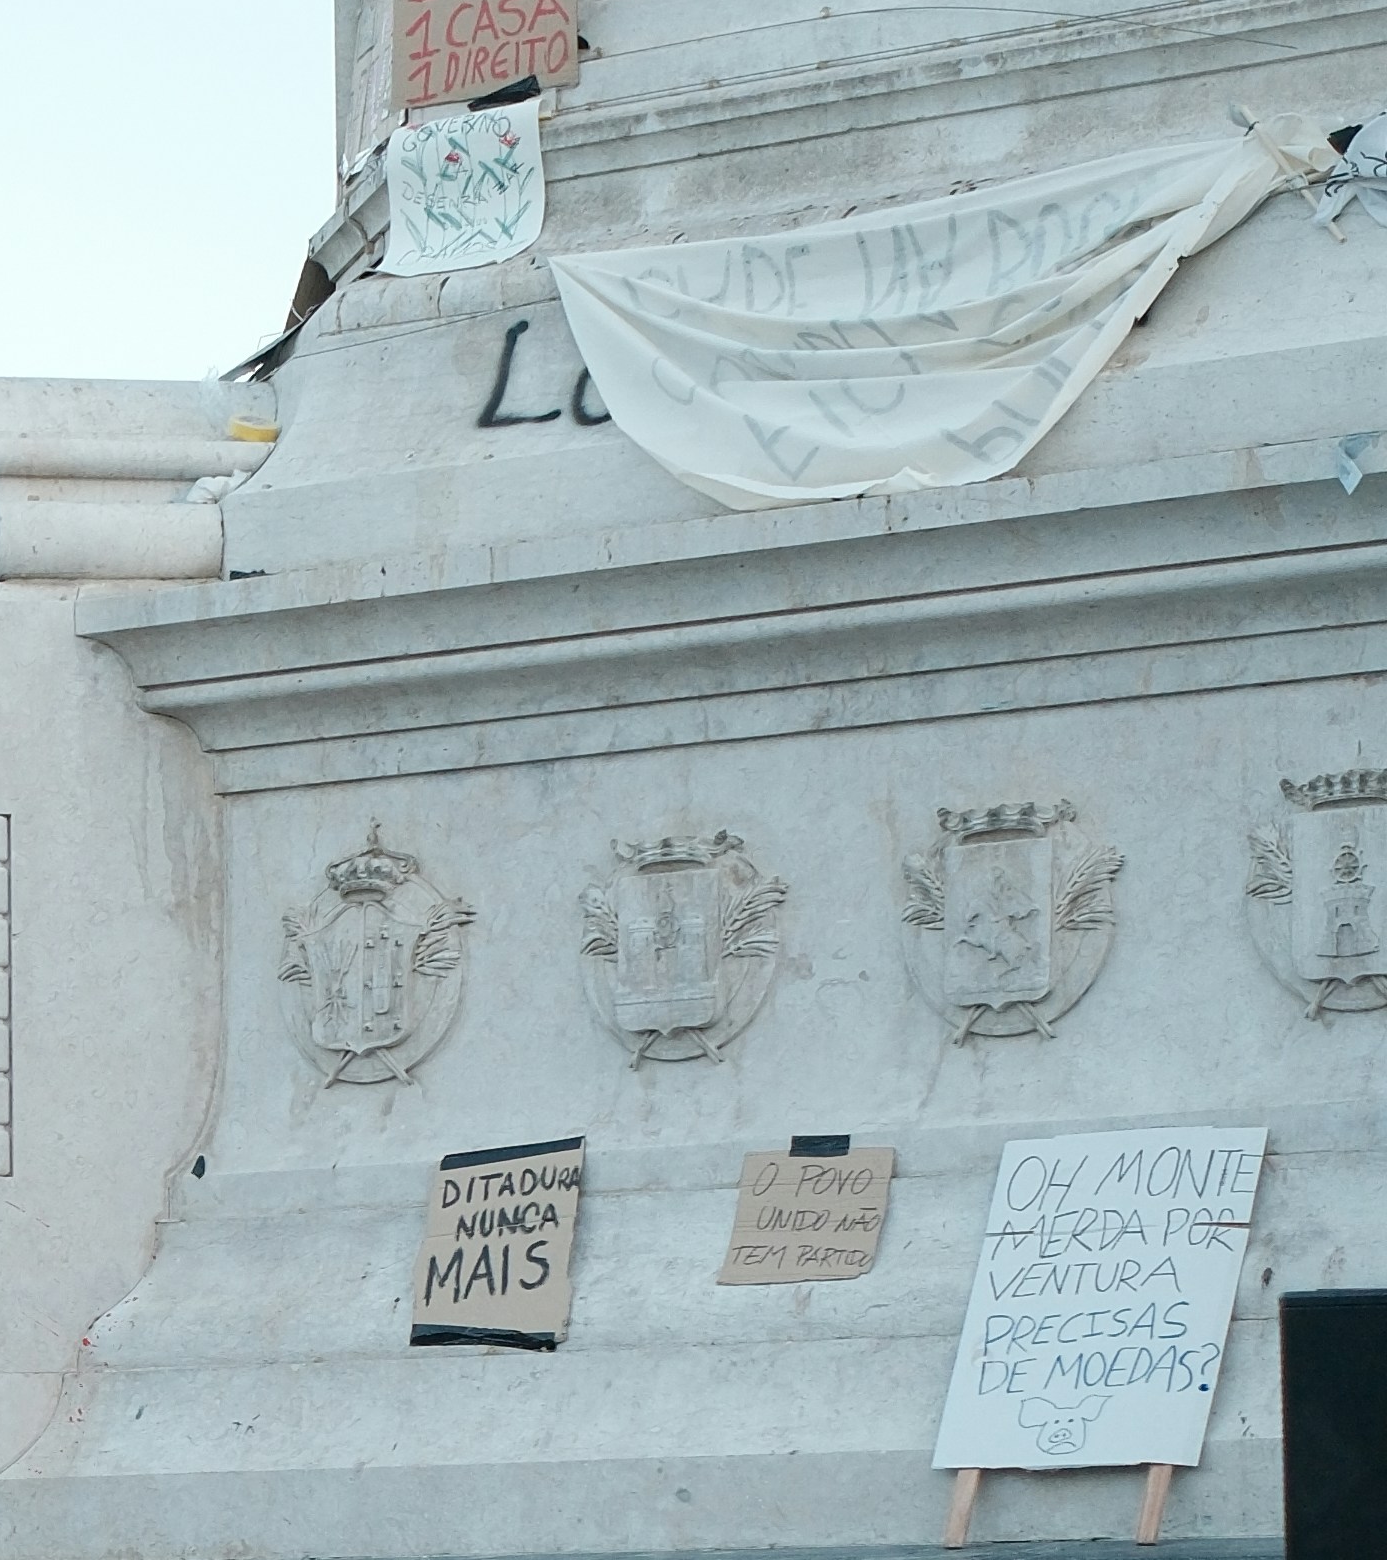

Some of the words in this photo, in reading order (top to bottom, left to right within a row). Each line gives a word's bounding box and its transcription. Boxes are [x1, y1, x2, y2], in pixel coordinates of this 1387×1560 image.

[406, 8, 440, 60] 1
[406, 56, 440, 105] 1
[444, 29, 570, 94] DIREITO
[441, 1165, 580, 1209] DITADURA
[752, 1161, 780, 1197] O
[795, 1164, 874, 1198] POVO
[1006, 1154, 1089, 1213] OH
[1094, 1146, 1264, 1199] MONTE
[456, 1201, 559, 1242] NUNCA
[756, 1205, 831, 1232] UNIDO
[834, 1206, 881, 1233] NÃO
[991, 1207, 1149, 1261] MERDA
[1162, 1207, 1235, 1252] POR
[424, 1239, 551, 1308] MAIS
[732, 1244, 787, 1270] TEM
[796, 1244, 873, 1269] PARTIDO
[988, 1256, 1182, 1301] VENTURA
[983, 1300, 1190, 1357] PRECISAS
[978, 1358, 1038, 1395] DE
[1043, 1342, 1221, 1393] MOEDAS?
